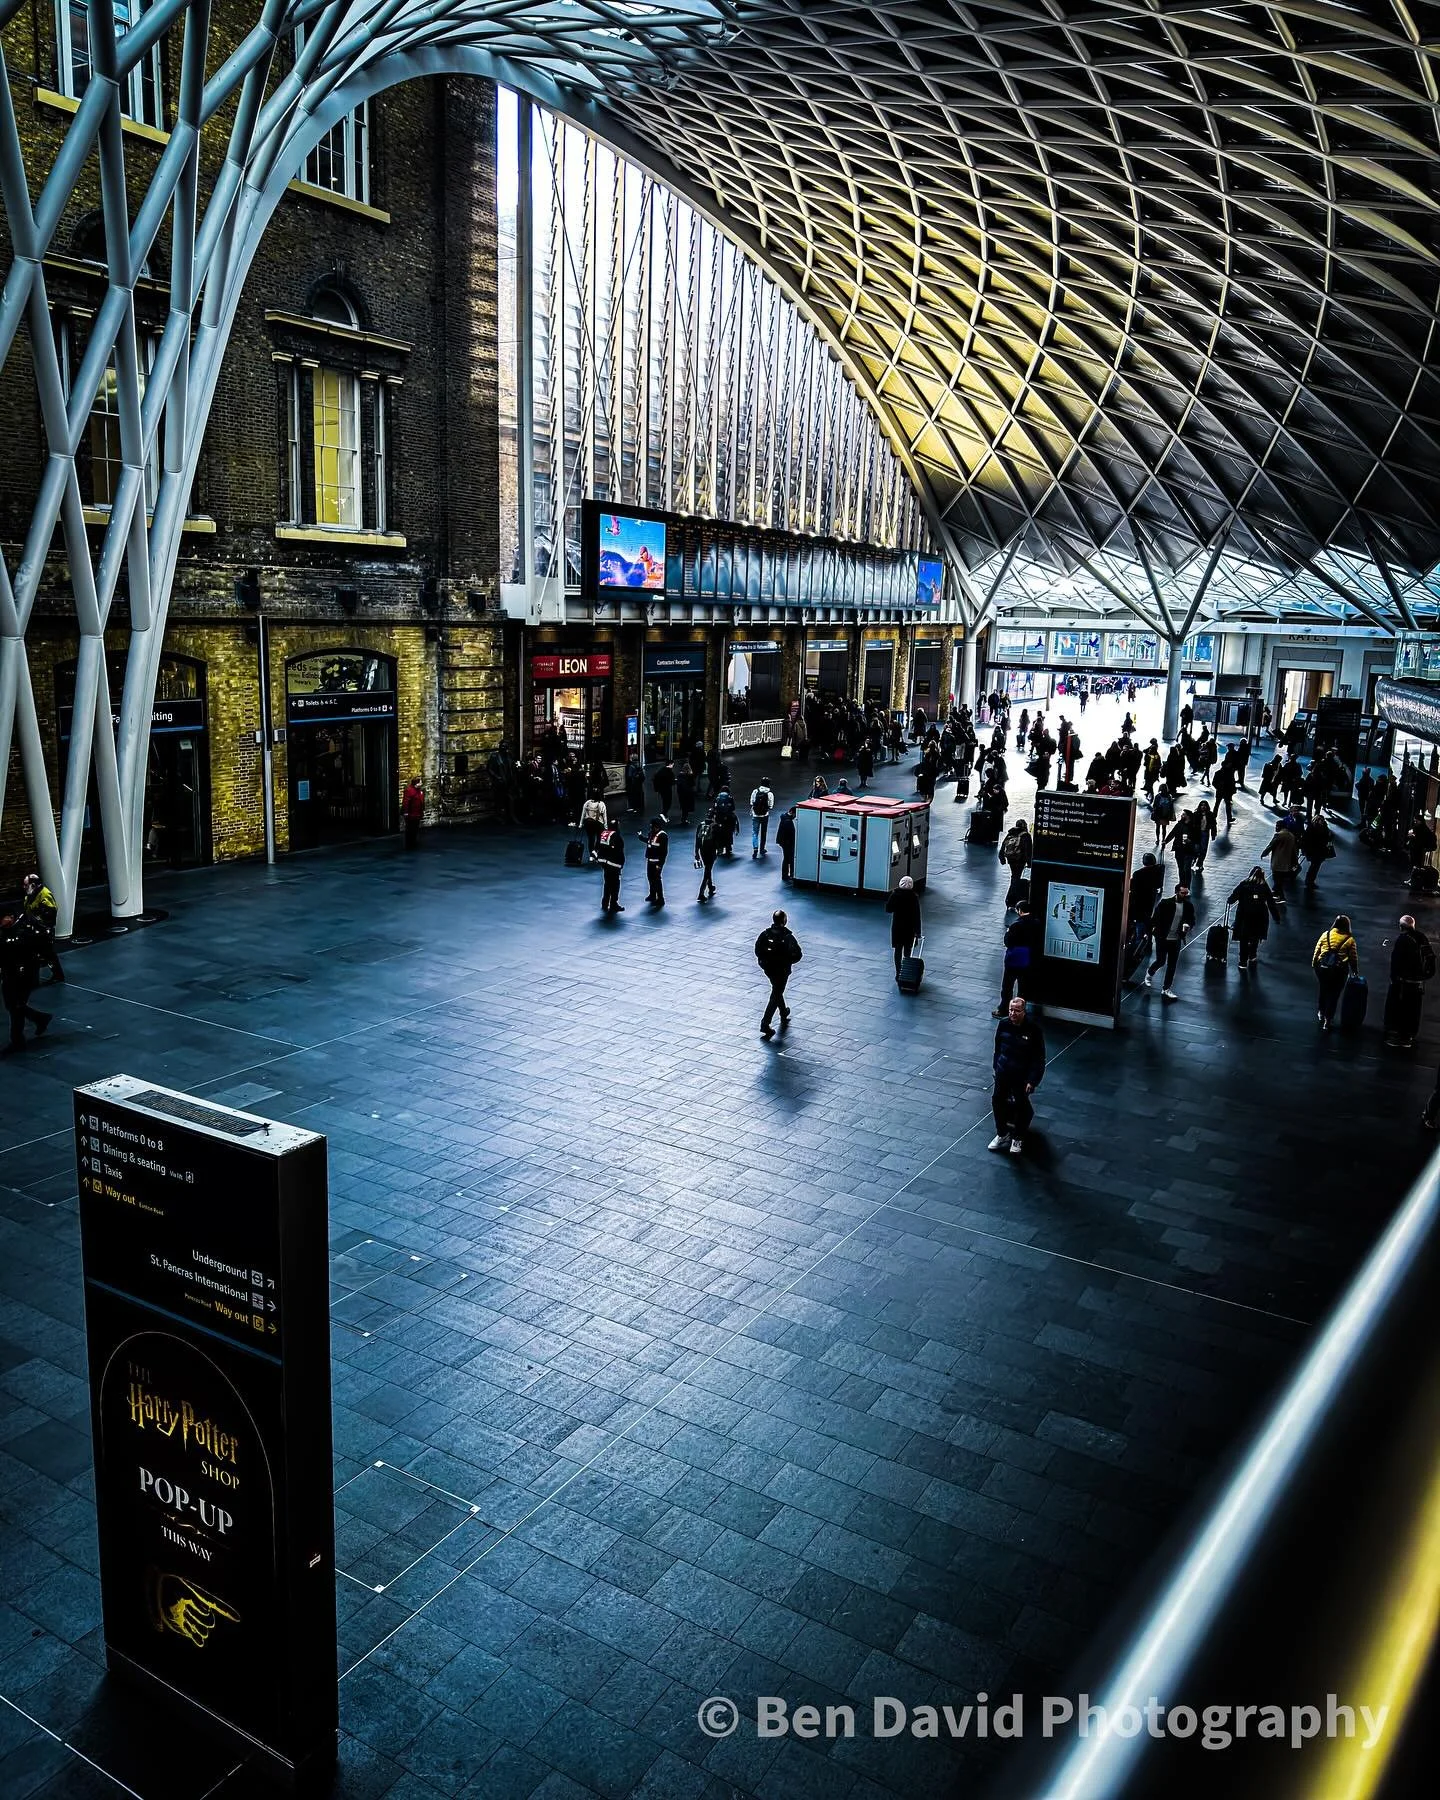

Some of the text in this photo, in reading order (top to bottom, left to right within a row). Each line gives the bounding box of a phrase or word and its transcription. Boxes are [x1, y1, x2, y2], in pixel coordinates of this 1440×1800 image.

[559, 658, 588, 675] LEON
[1083, 842, 1112, 850] Underground
[101, 1121, 164, 1151] Platforms 0 to 8
[102, 1143, 128, 1163] Dining
[129, 1152, 136, 1164] &
[137, 1157, 167, 1176] seating
[103, 1163, 123, 1180] Taxis
[105, 1184, 121, 1201] Way
[122, 1194, 136, 1206] out
[150, 1253, 249, 1302] St. Pancras International
[192, 1249, 248, 1280] Underground
[214, 1300, 233, 1319] Way
[234, 1310, 249, 1325] out
[126, 1382, 239, 1465] Harry Potter
[201, 1460, 240, 1490] SHOP
[138, 1466, 234, 1535] POP-UP
[161, 1525, 213, 1562] THIS WAY
